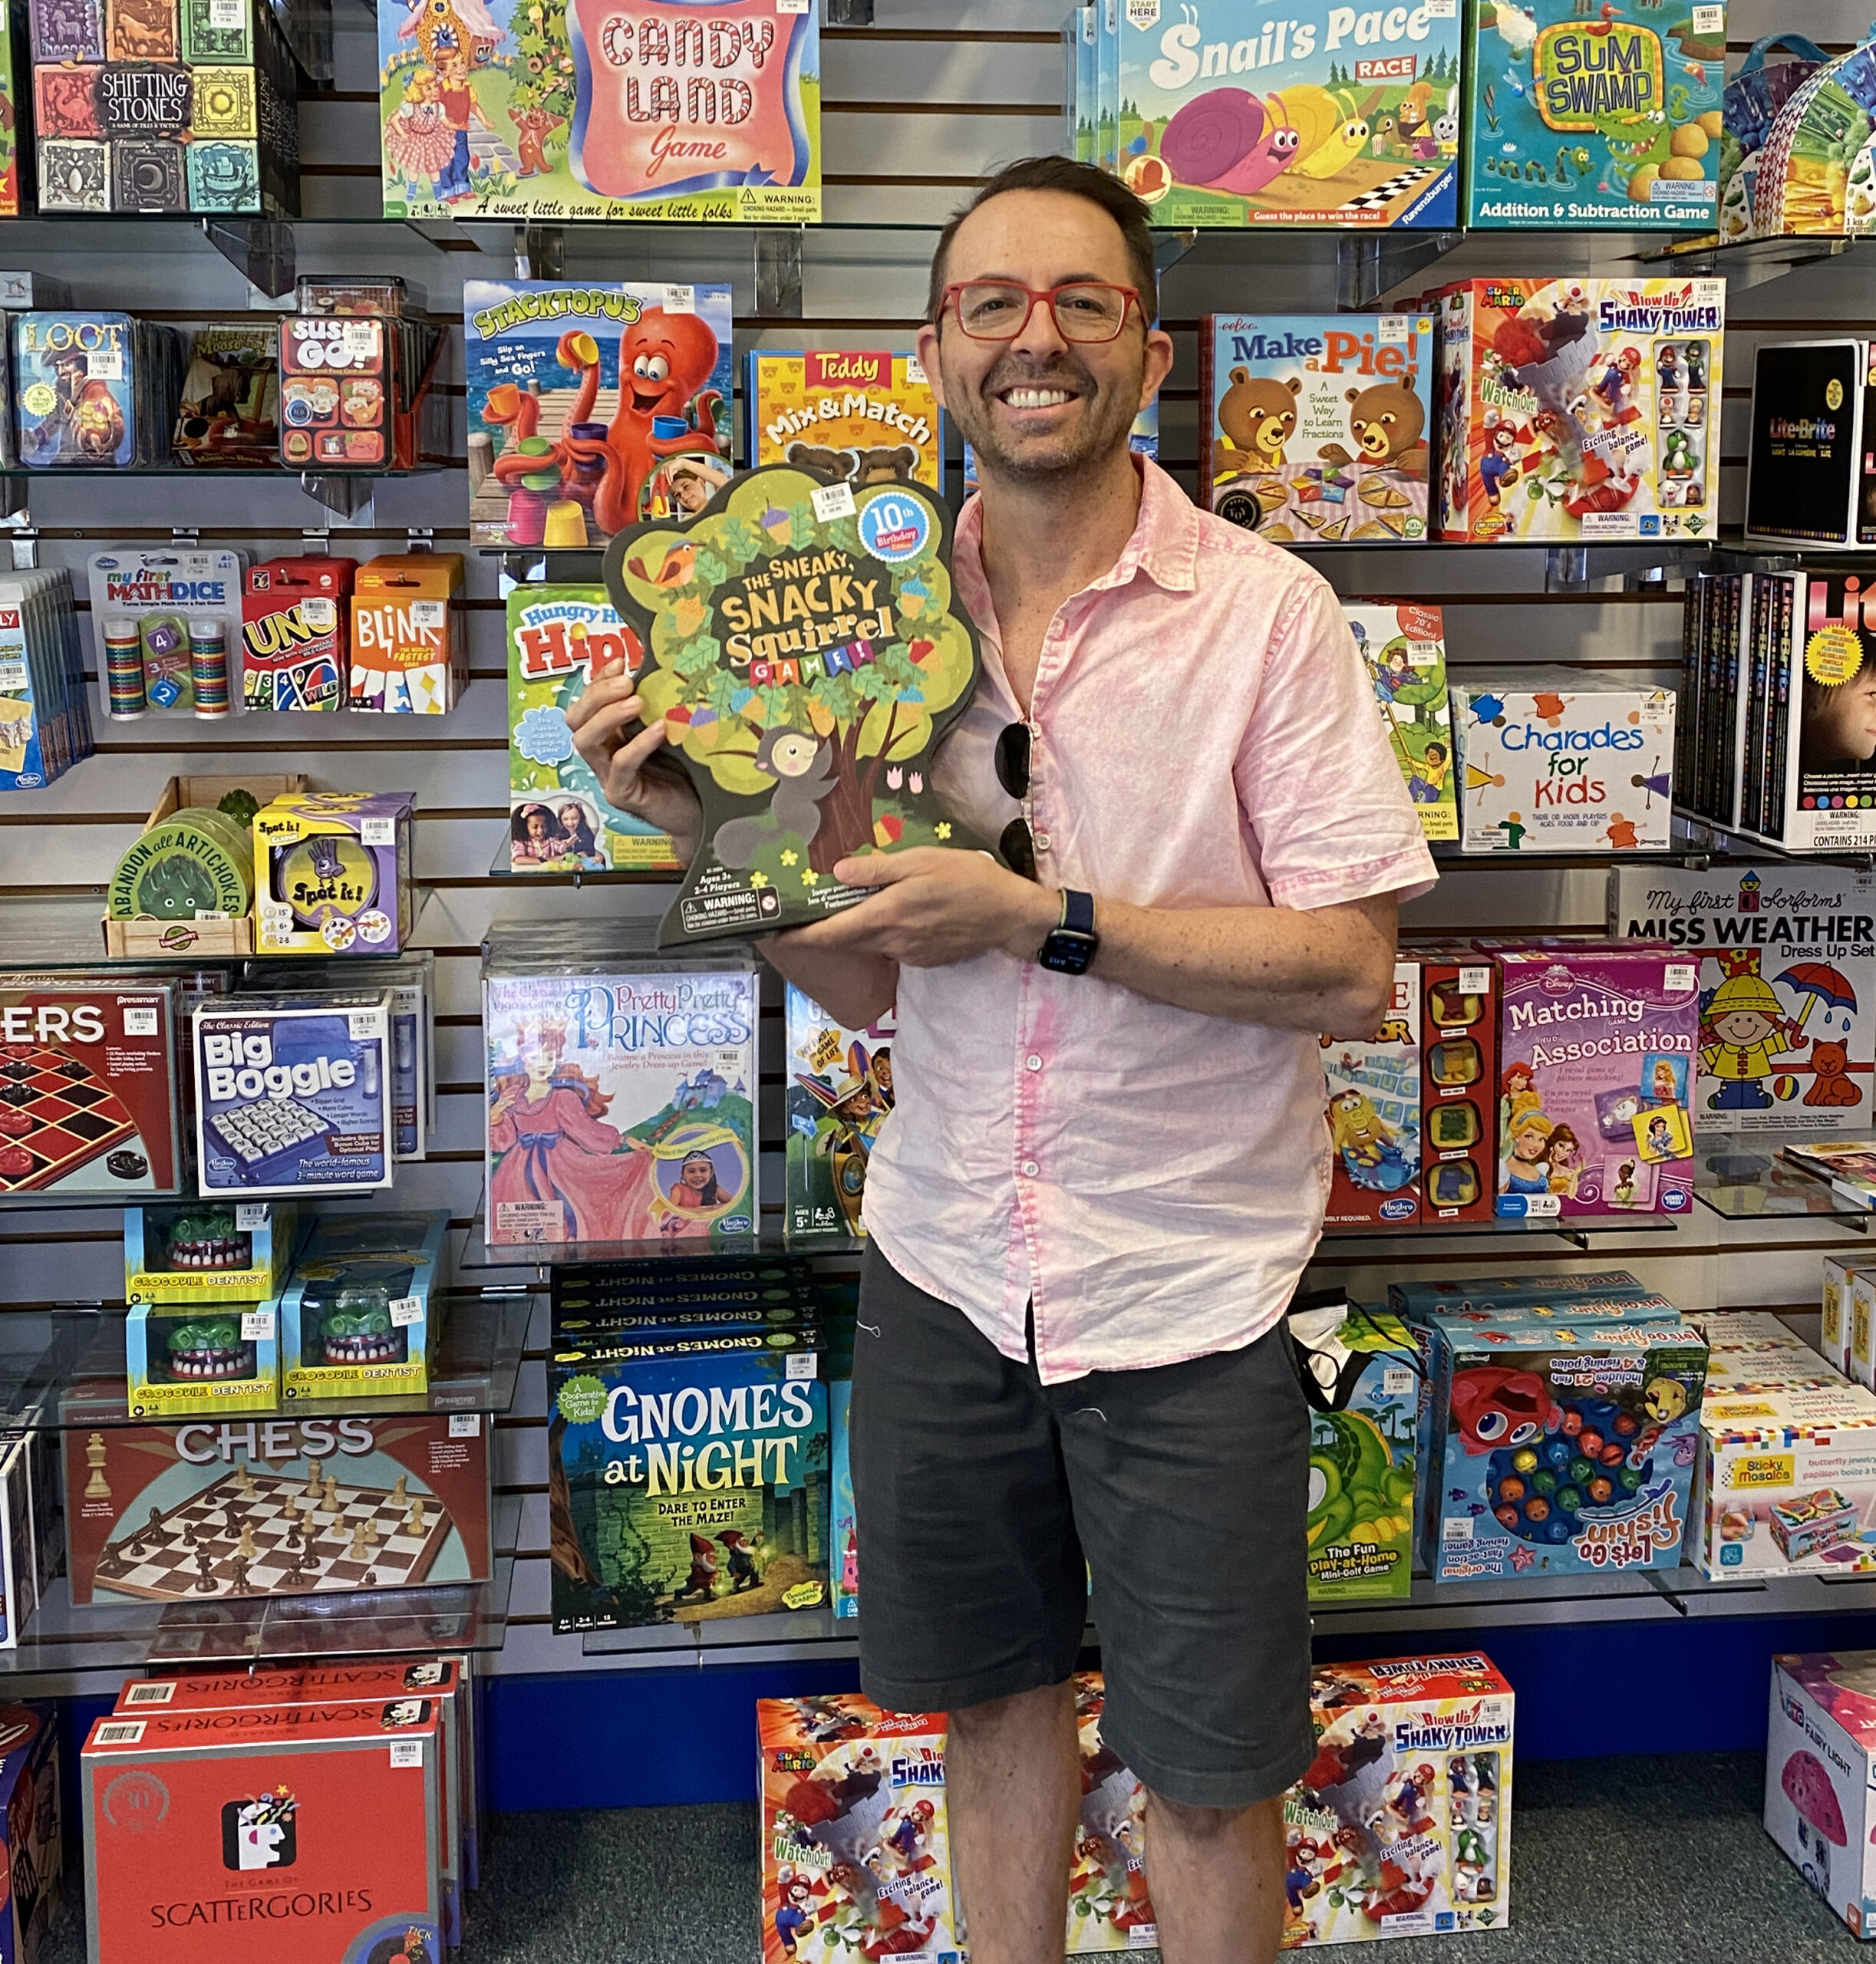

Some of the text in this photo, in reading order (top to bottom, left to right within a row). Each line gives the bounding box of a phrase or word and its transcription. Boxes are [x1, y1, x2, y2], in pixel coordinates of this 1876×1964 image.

[603, 18, 773, 68] CANDY
[1149, 7, 1430, 89] Snail's Pace
[1360, 58, 1413, 77] RACE
[102, 73, 188, 97] SHIFTING
[1547, 73, 1653, 114] SWAMP
[627, 76, 752, 124] LAND
[108, 97, 183, 122] STONES
[646, 125, 727, 178] Game
[764, 195, 815, 203] WARNING:
[1401, 172, 1454, 225] Ravensburger
[493, 200, 527, 216] sweet
[532, 197, 565, 216] little
[569, 203, 603, 219] game
[628, 201, 662, 216] sweet
[665, 199, 698, 216] little
[702, 199, 734, 220] folks
[1254, 212, 1277, 221] Guess
[1279, 212, 1294, 220] the
[1297, 212, 1317, 222] place
[1360, 212, 1380, 220] race!
[1480, 203, 1710, 219] Addition & Subtraction Game
[1487, 285, 1521, 296] SUPER
[1481, 295, 1525, 308] MARIO
[473, 289, 641, 340] STACKTOPUS
[1599, 302, 1720, 332] SHAKY TOWER
[26, 323, 124, 352] LOOT
[1232, 333, 1323, 362] Make
[1305, 331, 1419, 377] a Pie!
[480, 358, 498, 367] Silly
[518, 351, 546, 361] Fingers
[512, 361, 536, 375] Go!
[816, 353, 879, 381] Teddy
[1320, 381, 1328, 390] A
[1309, 394, 1338, 403] Sweet
[1481, 378, 1537, 413] Watch Out!
[767, 394, 931, 446] Mix Match
[1313, 405, 1335, 417] Way
[1304, 418, 1342, 427] to Learn
[1302, 430, 1344, 438] Fractions
[875, 529, 917, 547] Birthday
[769, 550, 854, 580] SNEAKY,
[107, 568, 172, 584] my first
[172, 582, 226, 600] DICE
[721, 575, 879, 632] SNACKY
[525, 605, 599, 628] Hungry
[726, 605, 895, 667] Squirrel
[303, 681, 338, 701] WILD
[526, 739, 566, 748] chomping
[1501, 722, 1644, 751] Charades
[1548, 752, 1589, 776] for
[1535, 776, 1607, 809] Kids
[259, 821, 282, 833] Spot
[1814, 835, 1868, 846] CONTAINS 214
[114, 832, 239, 915] ABANDON all ARTICHOKES
[700, 875, 720, 885] Ages
[709, 881, 740, 892] Players
[704, 893, 756, 911] WARNING:
[1647, 891, 1685, 916] My
[1686, 891, 1734, 914] first
[1627, 916, 1874, 945] MISS WEATHER
[1781, 943, 1874, 960] Dress Up Set
[496, 987, 558, 997] The Classic
[615, 984, 738, 1013] Pretty Pretty
[529, 1000, 562, 1009] Game
[1508, 994, 1645, 1032] Matching
[218, 1021, 270, 1030] Classic Edition
[565, 985, 750, 1051] PRINCESS
[203, 1031, 272, 1069] Big
[648, 1052, 684, 1060] Princess
[1531, 1029, 1692, 1071] Association
[610, 1058, 707, 1072] Jewelry Dress-up Game!
[206, 1056, 355, 1102] Boggle
[299, 1157, 370, 1169] The world-famous
[296, 1169, 379, 1181] 3-minute word game
[134, 1274, 268, 1287] CROCODILE DENTIST
[1550, 1358, 1621, 1369] fishing poles
[288, 1366, 421, 1381] CROCODILE DENTIST
[1596, 1373, 1643, 1385] Includes
[137, 1383, 272, 1399] CROCODILE DENTIST
[560, 1389, 607, 1402] Cooperative
[600, 1380, 813, 1444] GNOMES
[176, 1418, 374, 1465] CHESS
[603, 1455, 645, 1485] at
[1746, 1459, 1783, 1472] Sticky
[1808, 1458, 1847, 1467] butterfly
[1803, 1469, 1839, 1479] papillon
[658, 1497, 746, 1515] DARE TO ENTER
[671, 1511, 734, 1527] THE MAZE!
[1327, 1544, 1376, 1558] The Fun
[1579, 1535, 1653, 1567] Let's Go
[1311, 1550, 1397, 1574] Play-at-Home
[1320, 1563, 1390, 1580] Mini-Golf Game
[1395, 1724, 1508, 1751] SHAKY TOWER
[1805, 1723, 1826, 1751] FAIRY
[777, 1751, 811, 1761] SUPER
[1828, 1745, 1851, 1778] LIGHT
[772, 1758, 816, 1773] MARIO
[1285, 1801, 1337, 1829] Watch Out!
